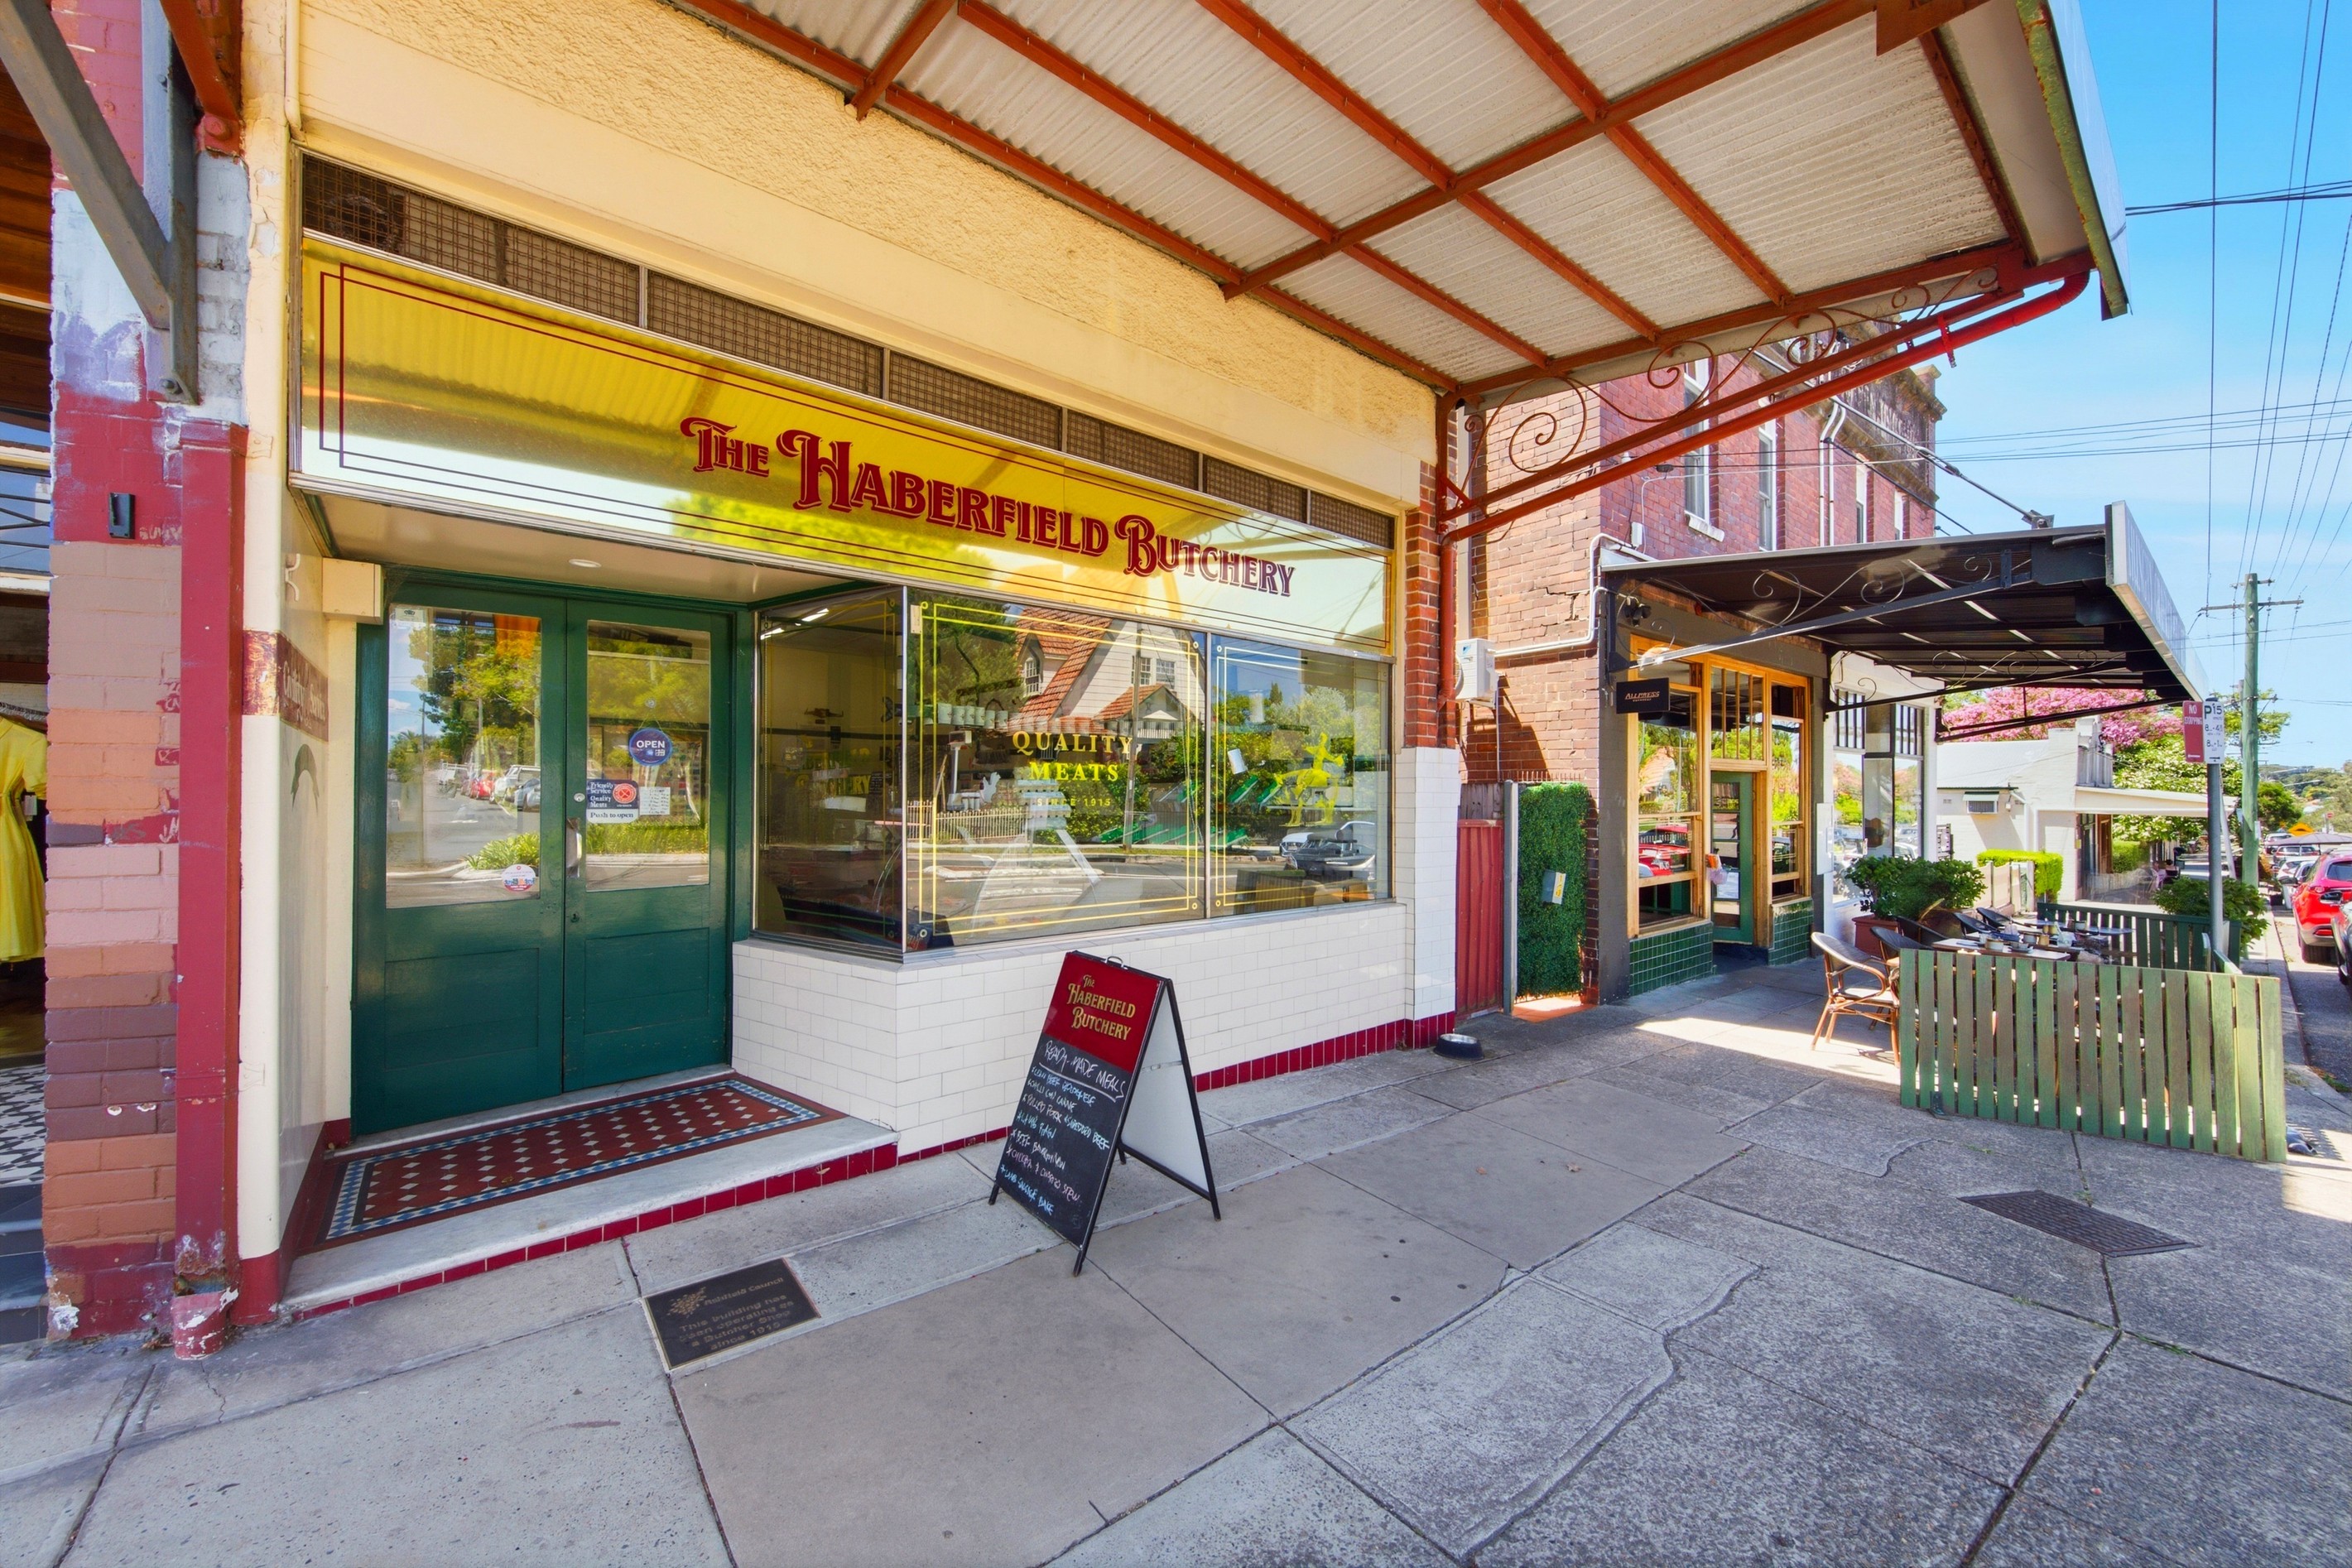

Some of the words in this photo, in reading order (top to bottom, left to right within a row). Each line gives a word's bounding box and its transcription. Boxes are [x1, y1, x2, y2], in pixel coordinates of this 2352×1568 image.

[680, 416, 770, 478] THE
[776, 431, 1110, 558] HABERFIELD
[1114, 513, 1296, 598] BUTCHERY
[2188, 704, 2197, 714] NO
[636, 740, 666, 748] OPEN
[1012, 730, 1133, 756] QUALITY
[1029, 762, 1118, 782] MEATS
[589, 795, 612, 803] Quality
[1037, 798, 1076, 807] SINCE
[1066, 983, 1136, 1019] HABERFIELD
[1071, 1006, 1132, 1041] BUTCHERY
[1095, 1070, 1126, 1099] MEALS
[1056, 1095, 1078, 1113] CARNE
[1046, 1104, 1061, 1124] PORK
[1092, 1132, 1110, 1151] BEEF
[1037, 1195, 1055, 1217] BAKE
[704, 1288, 747, 1306] Ashfield
[748, 1277, 784, 1292] Council
[679, 1319, 708, 1333] This
[711, 1301, 762, 1324] building
[765, 1294, 787, 1306] has
[679, 1326, 713, 1343] been
[717, 1306, 777, 1330] operating
[691, 1340, 700, 1348] a
[704, 1321, 756, 1344] Butcher
[758, 1310, 791, 1324] Shop
[710, 1335, 746, 1351] since
